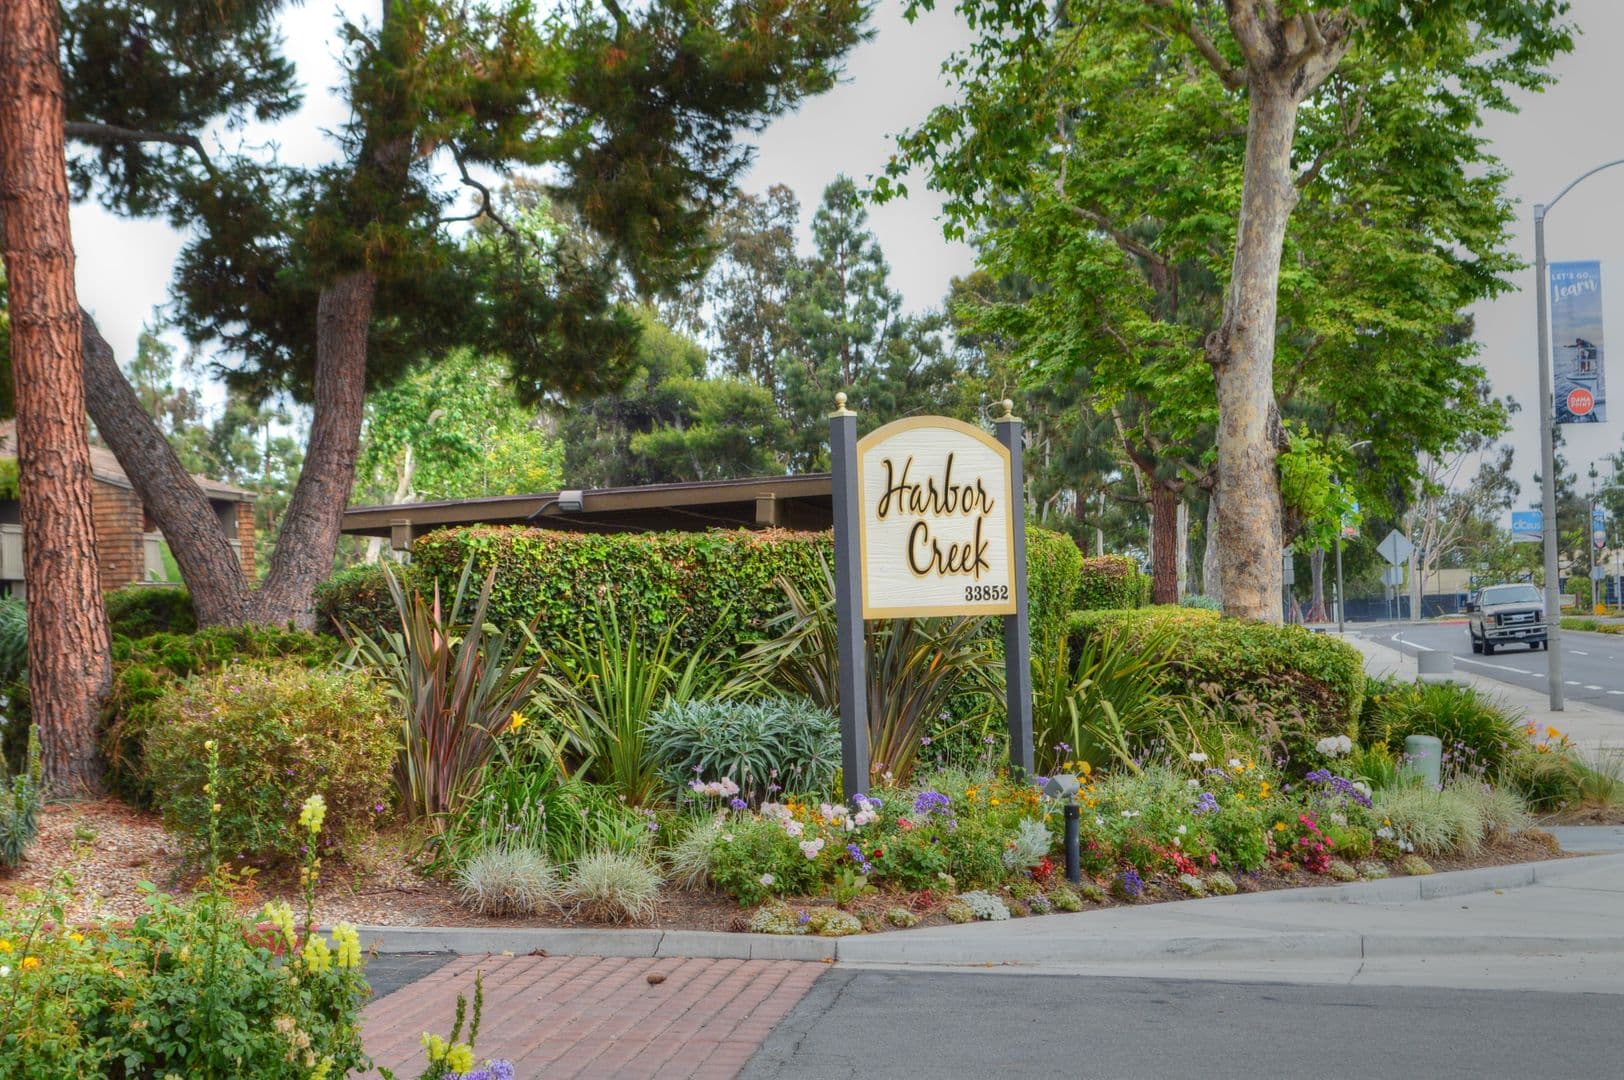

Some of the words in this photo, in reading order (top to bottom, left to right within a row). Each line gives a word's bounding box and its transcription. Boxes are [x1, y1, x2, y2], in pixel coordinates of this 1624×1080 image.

[877, 451, 995, 518] Harbor
[909, 516, 990, 578] Creek
[965, 585, 1009, 602] 33852
